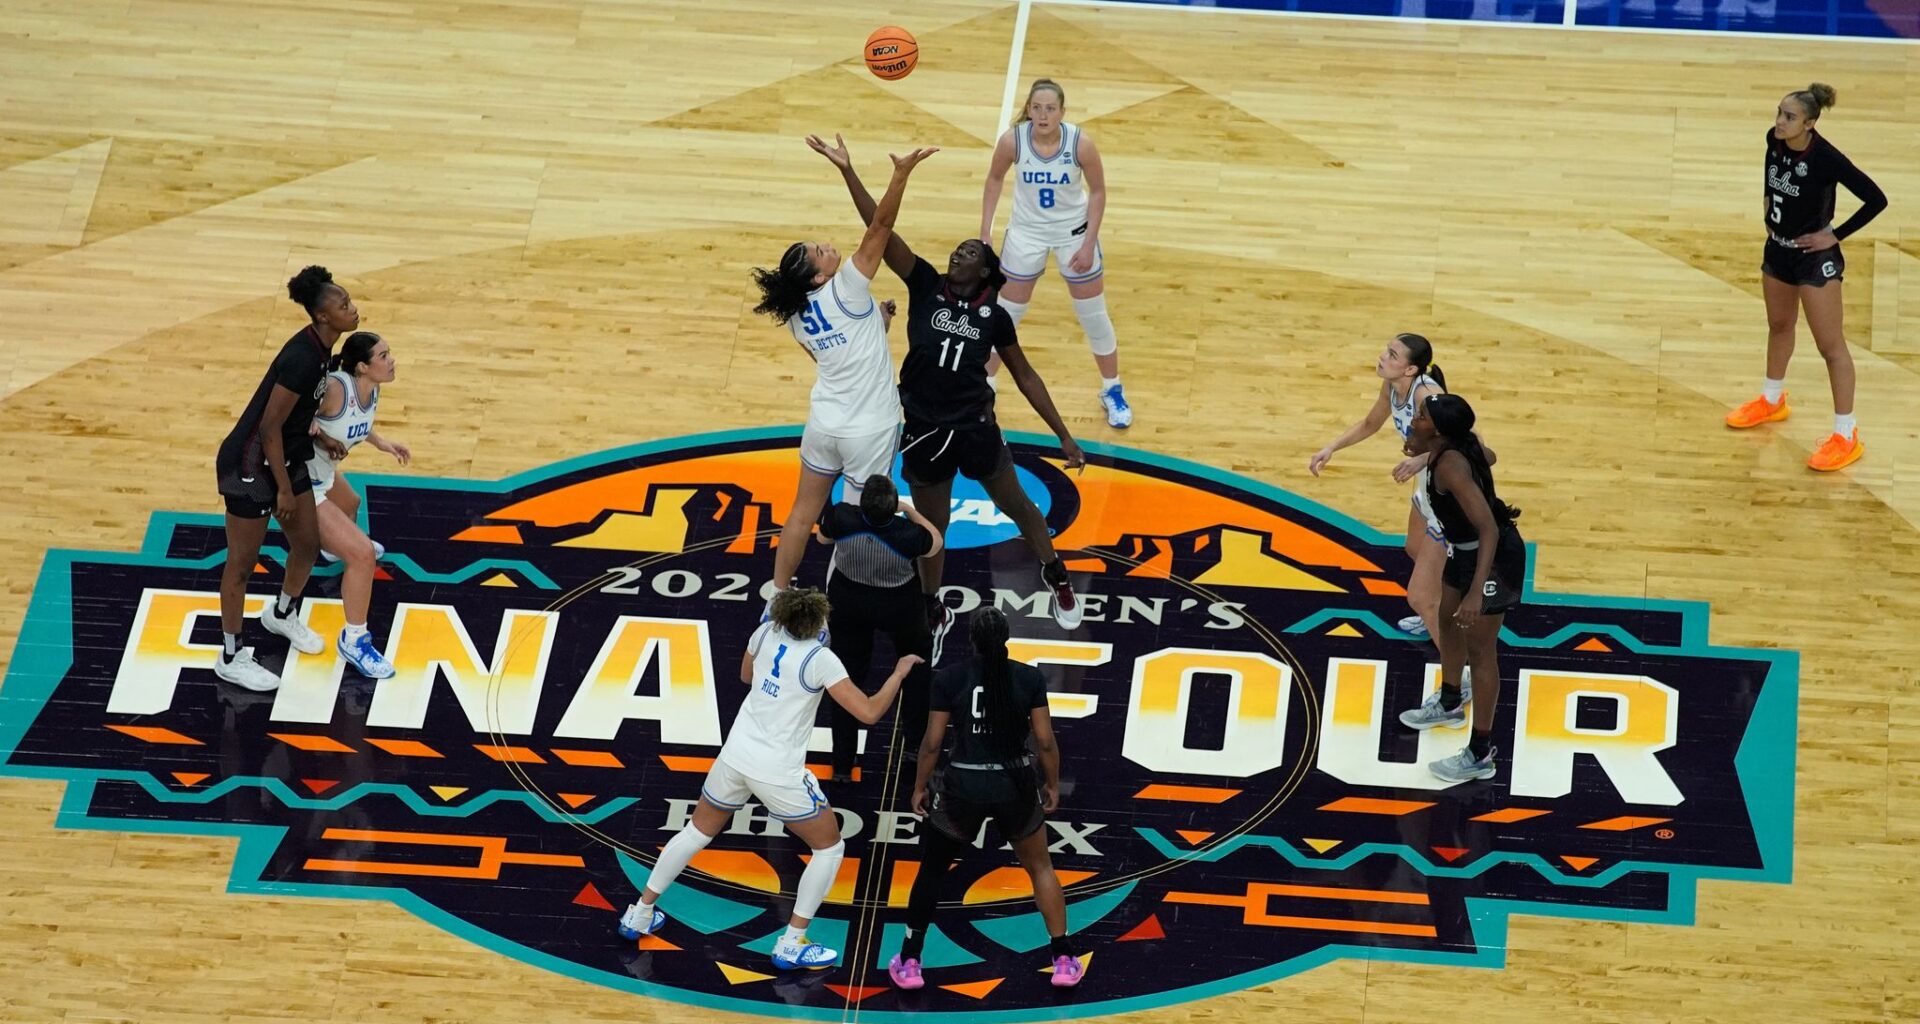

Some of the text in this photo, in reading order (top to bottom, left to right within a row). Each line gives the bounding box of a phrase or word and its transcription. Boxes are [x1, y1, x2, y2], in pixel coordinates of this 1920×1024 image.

[871, 60, 908, 73] Wilson
[872, 45, 899, 57] NCAA
[1023, 171, 1071, 185] UCLA
[1768, 164, 1800, 197] Carolina
[1038, 188, 1055, 209] 8
[1770, 193, 1783, 225] 5
[800, 300, 833, 336] 51
[931, 308, 980, 340] Carolina
[815, 332, 847, 350] BETTS
[938, 337, 965, 372] 11
[347, 422, 369, 439] UCL
[937, 585, 1247, 630] OMEN'S
[106, 588, 867, 756] FINA
[771, 644, 788, 679] 1
[761, 679, 780, 698] RICE
